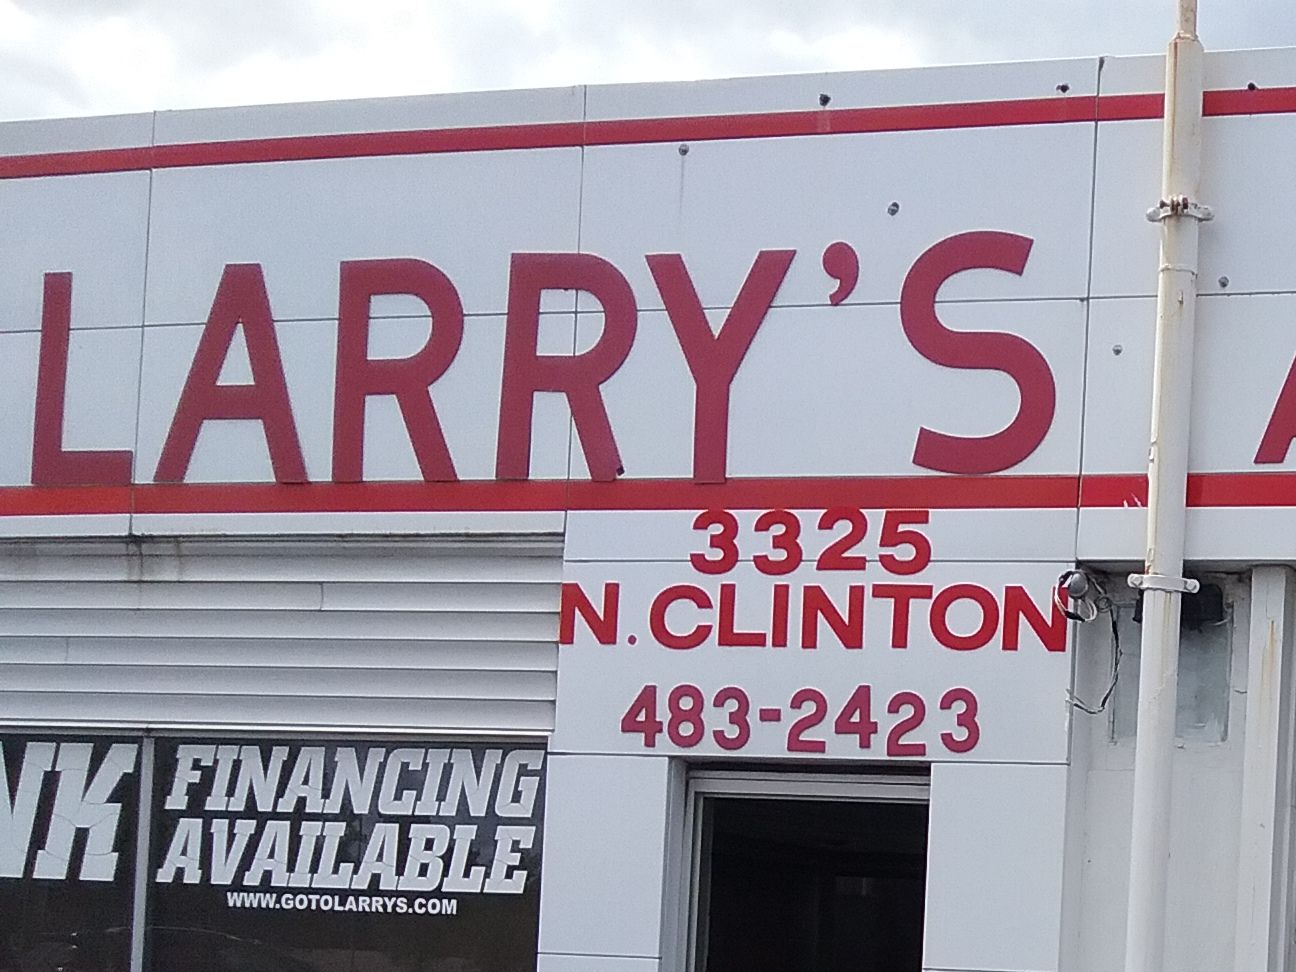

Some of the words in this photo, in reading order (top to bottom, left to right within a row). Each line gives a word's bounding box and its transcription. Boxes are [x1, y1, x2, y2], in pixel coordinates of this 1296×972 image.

[31, 230, 1056, 484] LARRY'S
[690, 508, 931, 576] 3325
[621, 684, 980, 756] 483-2423
[164, 744, 546, 818] FINANCING
[155, 818, 536, 894] AVAILABLE
[227, 892, 457, 915] WWW.GOTOLARRYS.COM
